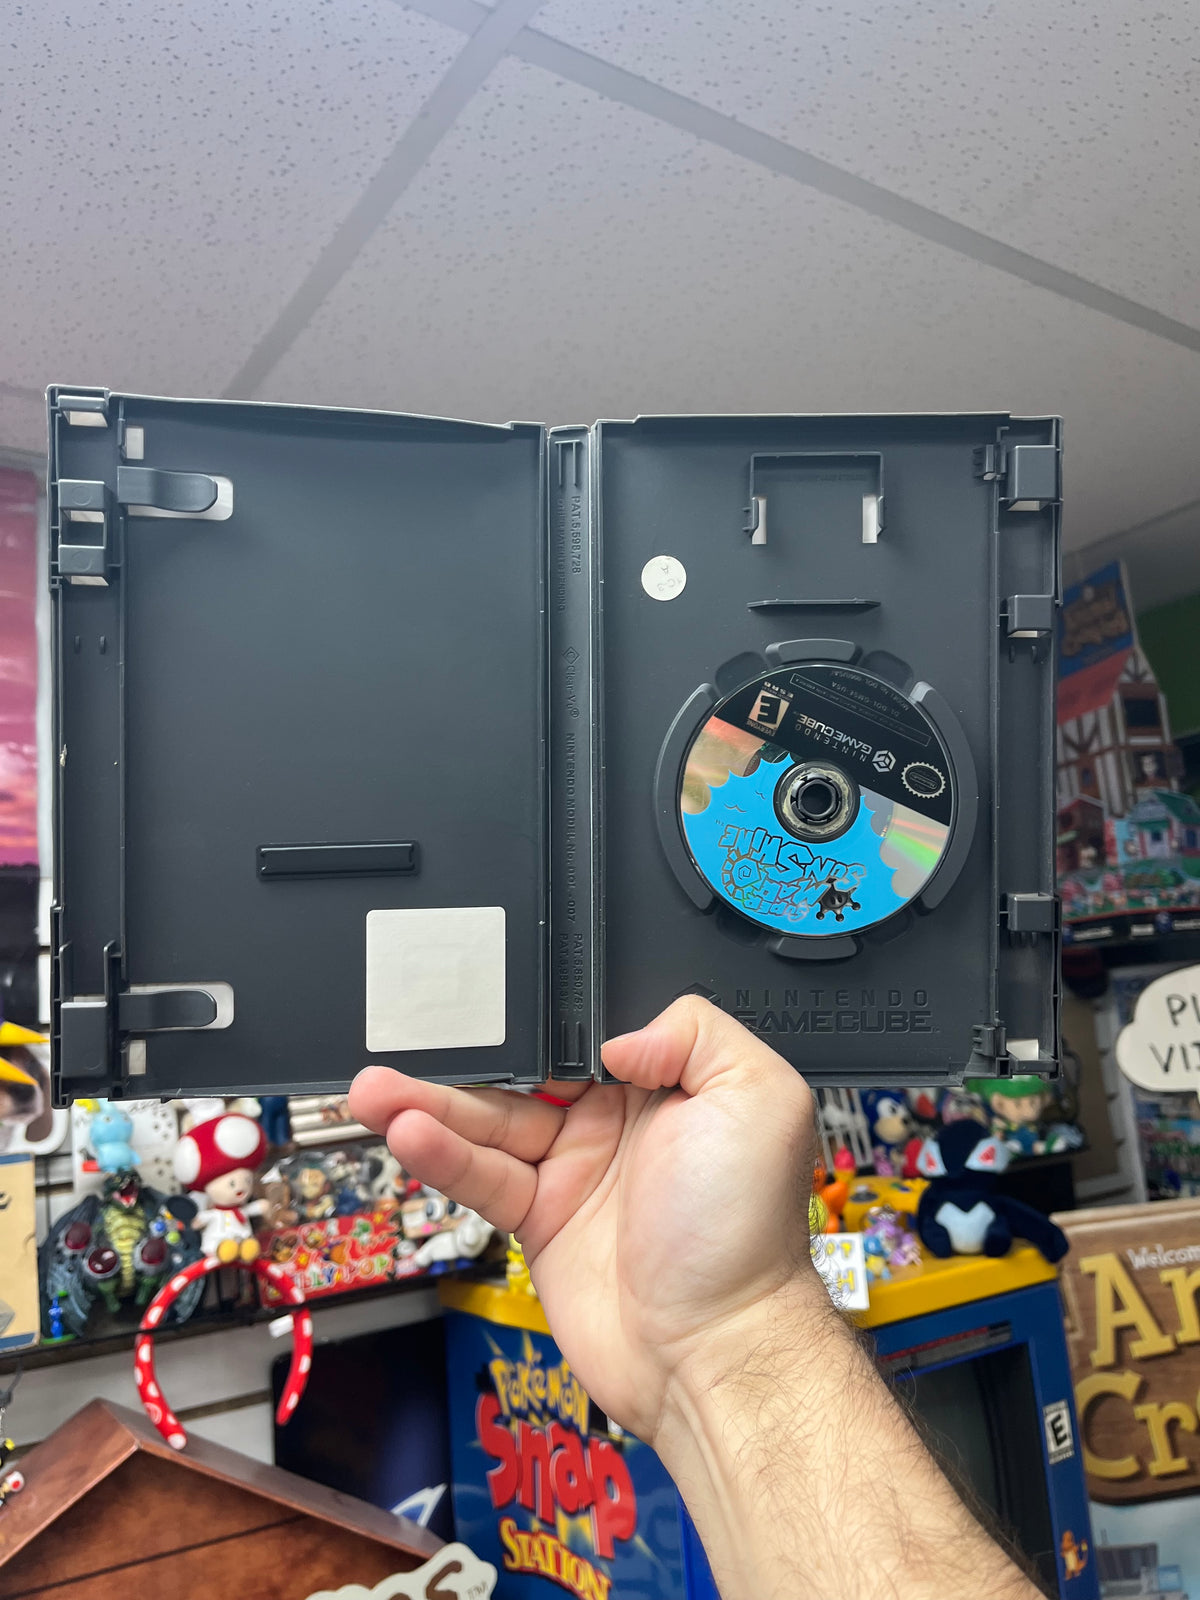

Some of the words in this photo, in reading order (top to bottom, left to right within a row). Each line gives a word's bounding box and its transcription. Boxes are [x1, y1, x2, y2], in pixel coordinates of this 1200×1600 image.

[757, 695, 782, 725] E
[794, 723, 868, 763] NINTENDO
[797, 713, 873, 755] GAMECUBE
[566, 732, 576, 797] NINTENDO
[736, 989, 930, 1008] NINTENDO
[1049, 1415, 1066, 1447] E
[476, 1392, 638, 1559] Snap
